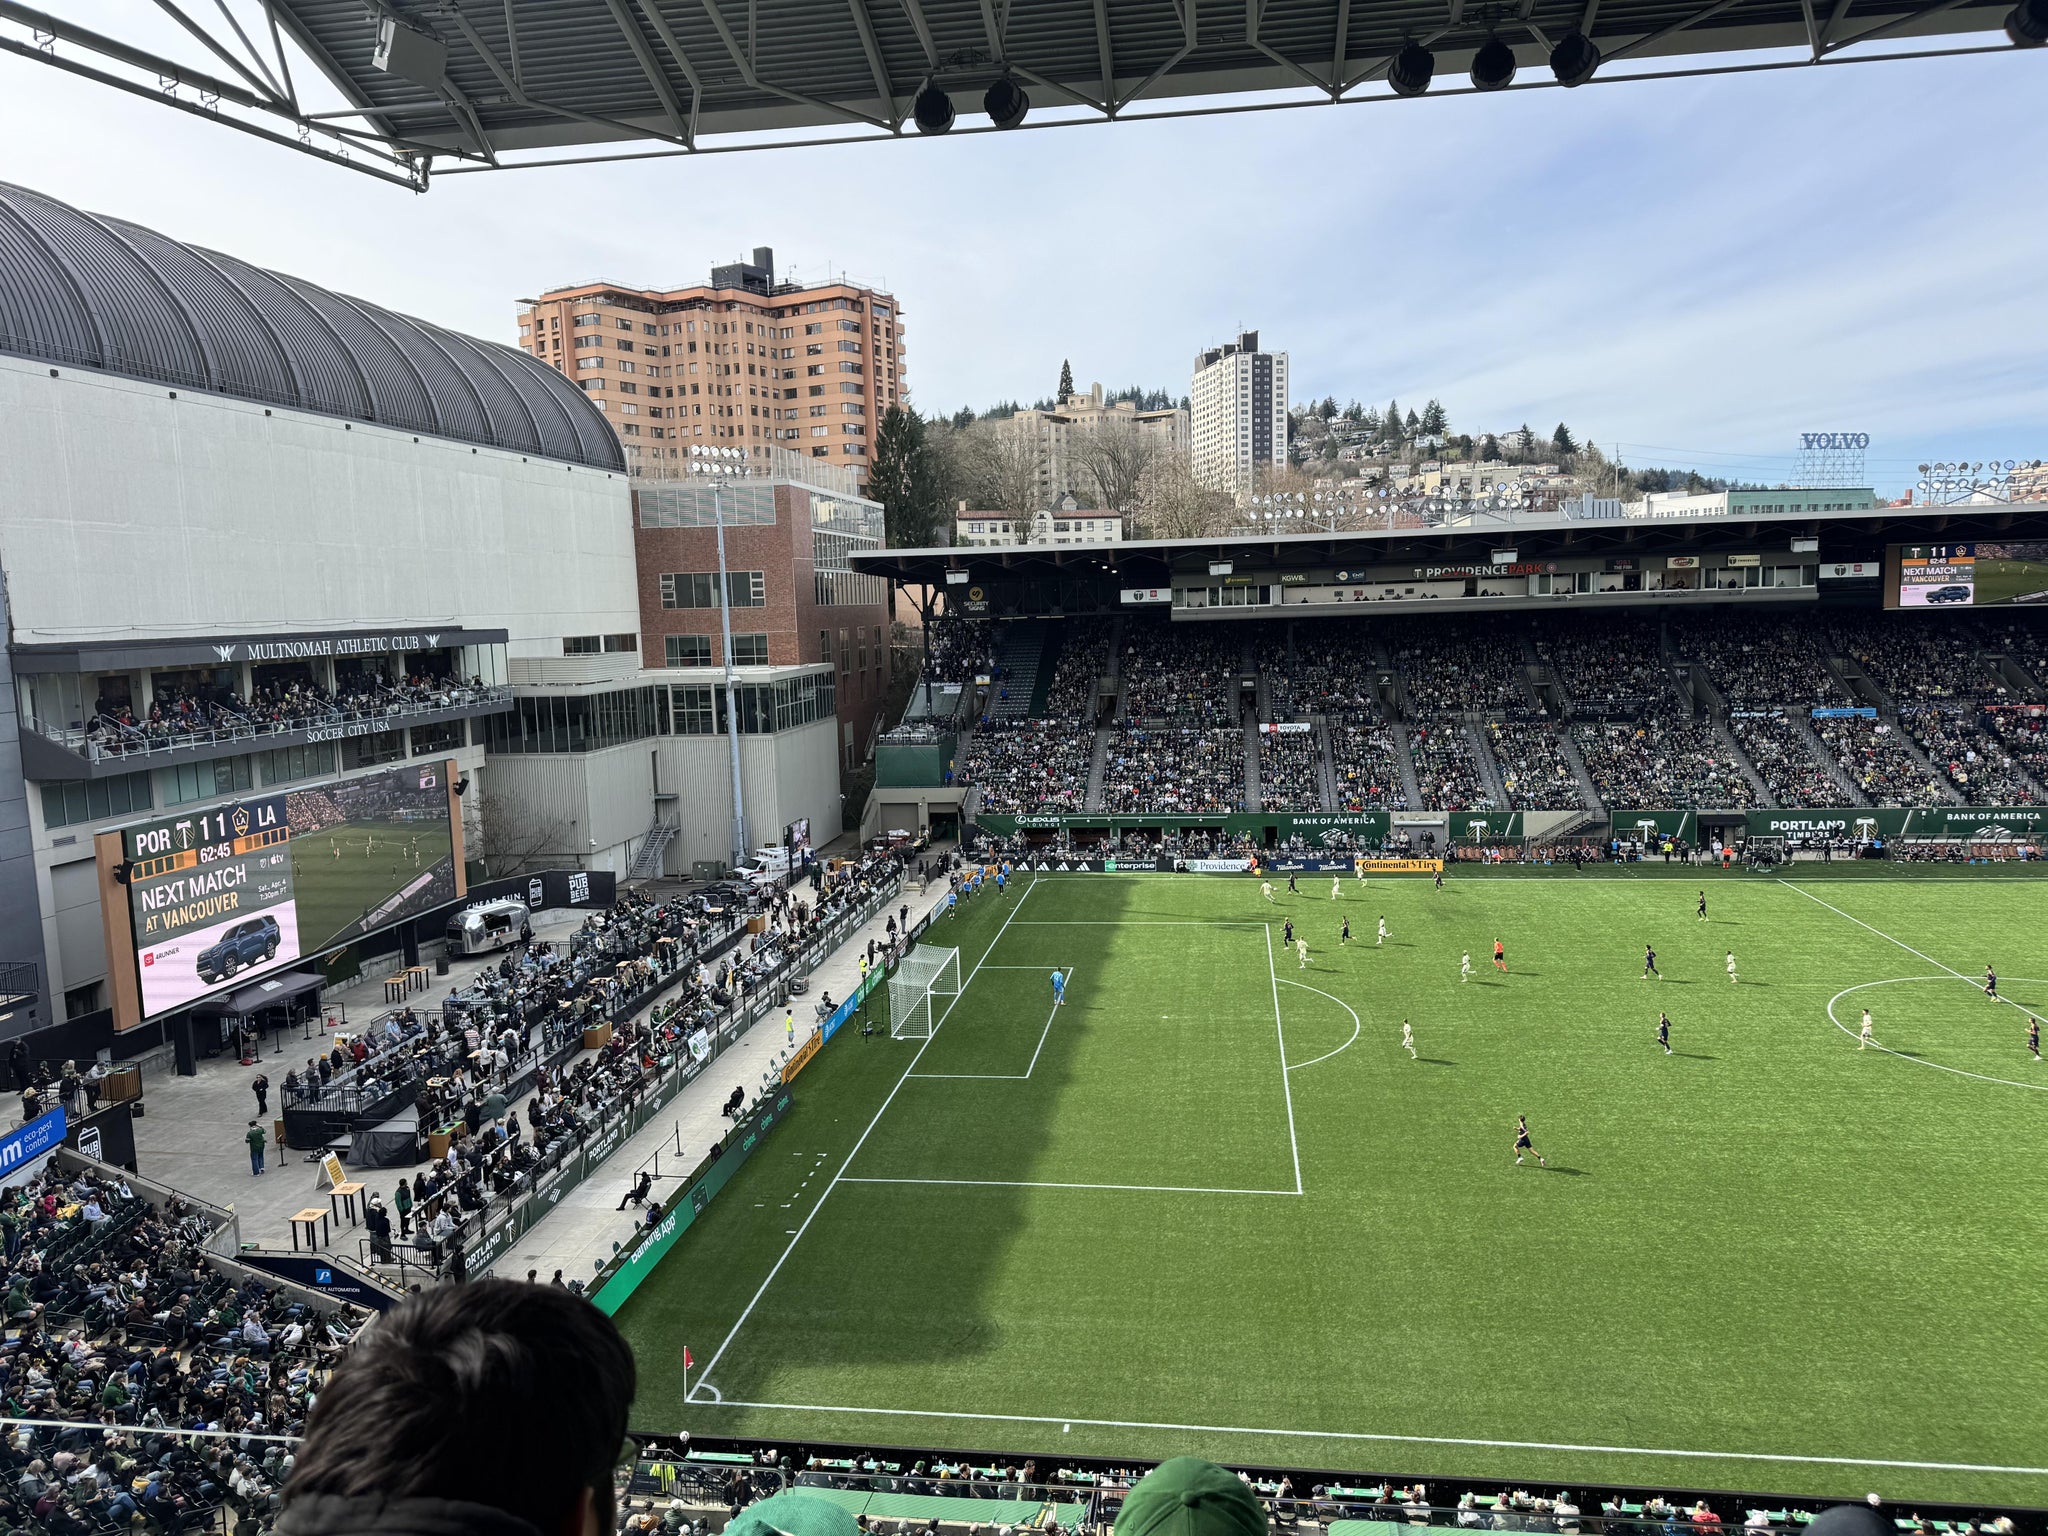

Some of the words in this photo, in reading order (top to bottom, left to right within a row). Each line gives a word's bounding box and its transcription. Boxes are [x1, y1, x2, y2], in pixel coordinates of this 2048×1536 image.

[1801, 432, 1870, 450] VOLVO
[1931, 546, 1936, 556] 1
[1940, 546, 1946, 556] 1
[1426, 565, 1508, 577] PROVIDENCE
[1509, 563, 1542, 574] PARK
[248, 641, 331, 660] MULTNOMAH
[336, 637, 388, 655] ATHLETIC
[392, 636, 419, 650] CLUB
[307, 727, 344, 744] SOCCER
[348, 724, 369, 737] CITY
[374, 721, 390, 732] USA
[136, 828, 171, 856] POR
[200, 816, 209, 840] 1
[216, 813, 226, 837] 1
[258, 805, 276, 827] LA
[1770, 820, 1845, 830] PORTLAND
[200, 842, 230, 863] 62:45
[1106, 861, 1156, 870] enterprise
[1200, 861, 1246, 870] Providence
[1276, 863, 1304, 871] Tillamook
[1318, 863, 1347, 871] Tillamook
[1362, 861, 1409, 870] Continental
[142, 880, 185, 912] NEXT
[189, 863, 247, 898] MATCH
[569, 877, 588, 890] PUB
[502, 892, 525, 900] FUN.
[570, 888, 589, 899] BEER
[145, 915, 159, 932] AT
[162, 891, 239, 930] VANCOUVER
[156, 947, 180, 960] 4RUNNER
[24, 1120, 52, 1142] eco-pest
[25, 1132, 49, 1153] control
[81, 1141, 99, 1155] PUB
[589, 1128, 618, 1160] PORTLAND
[465, 1232, 500, 1269] ORTLAND
[469, 1250, 493, 1274] TIMBERS
